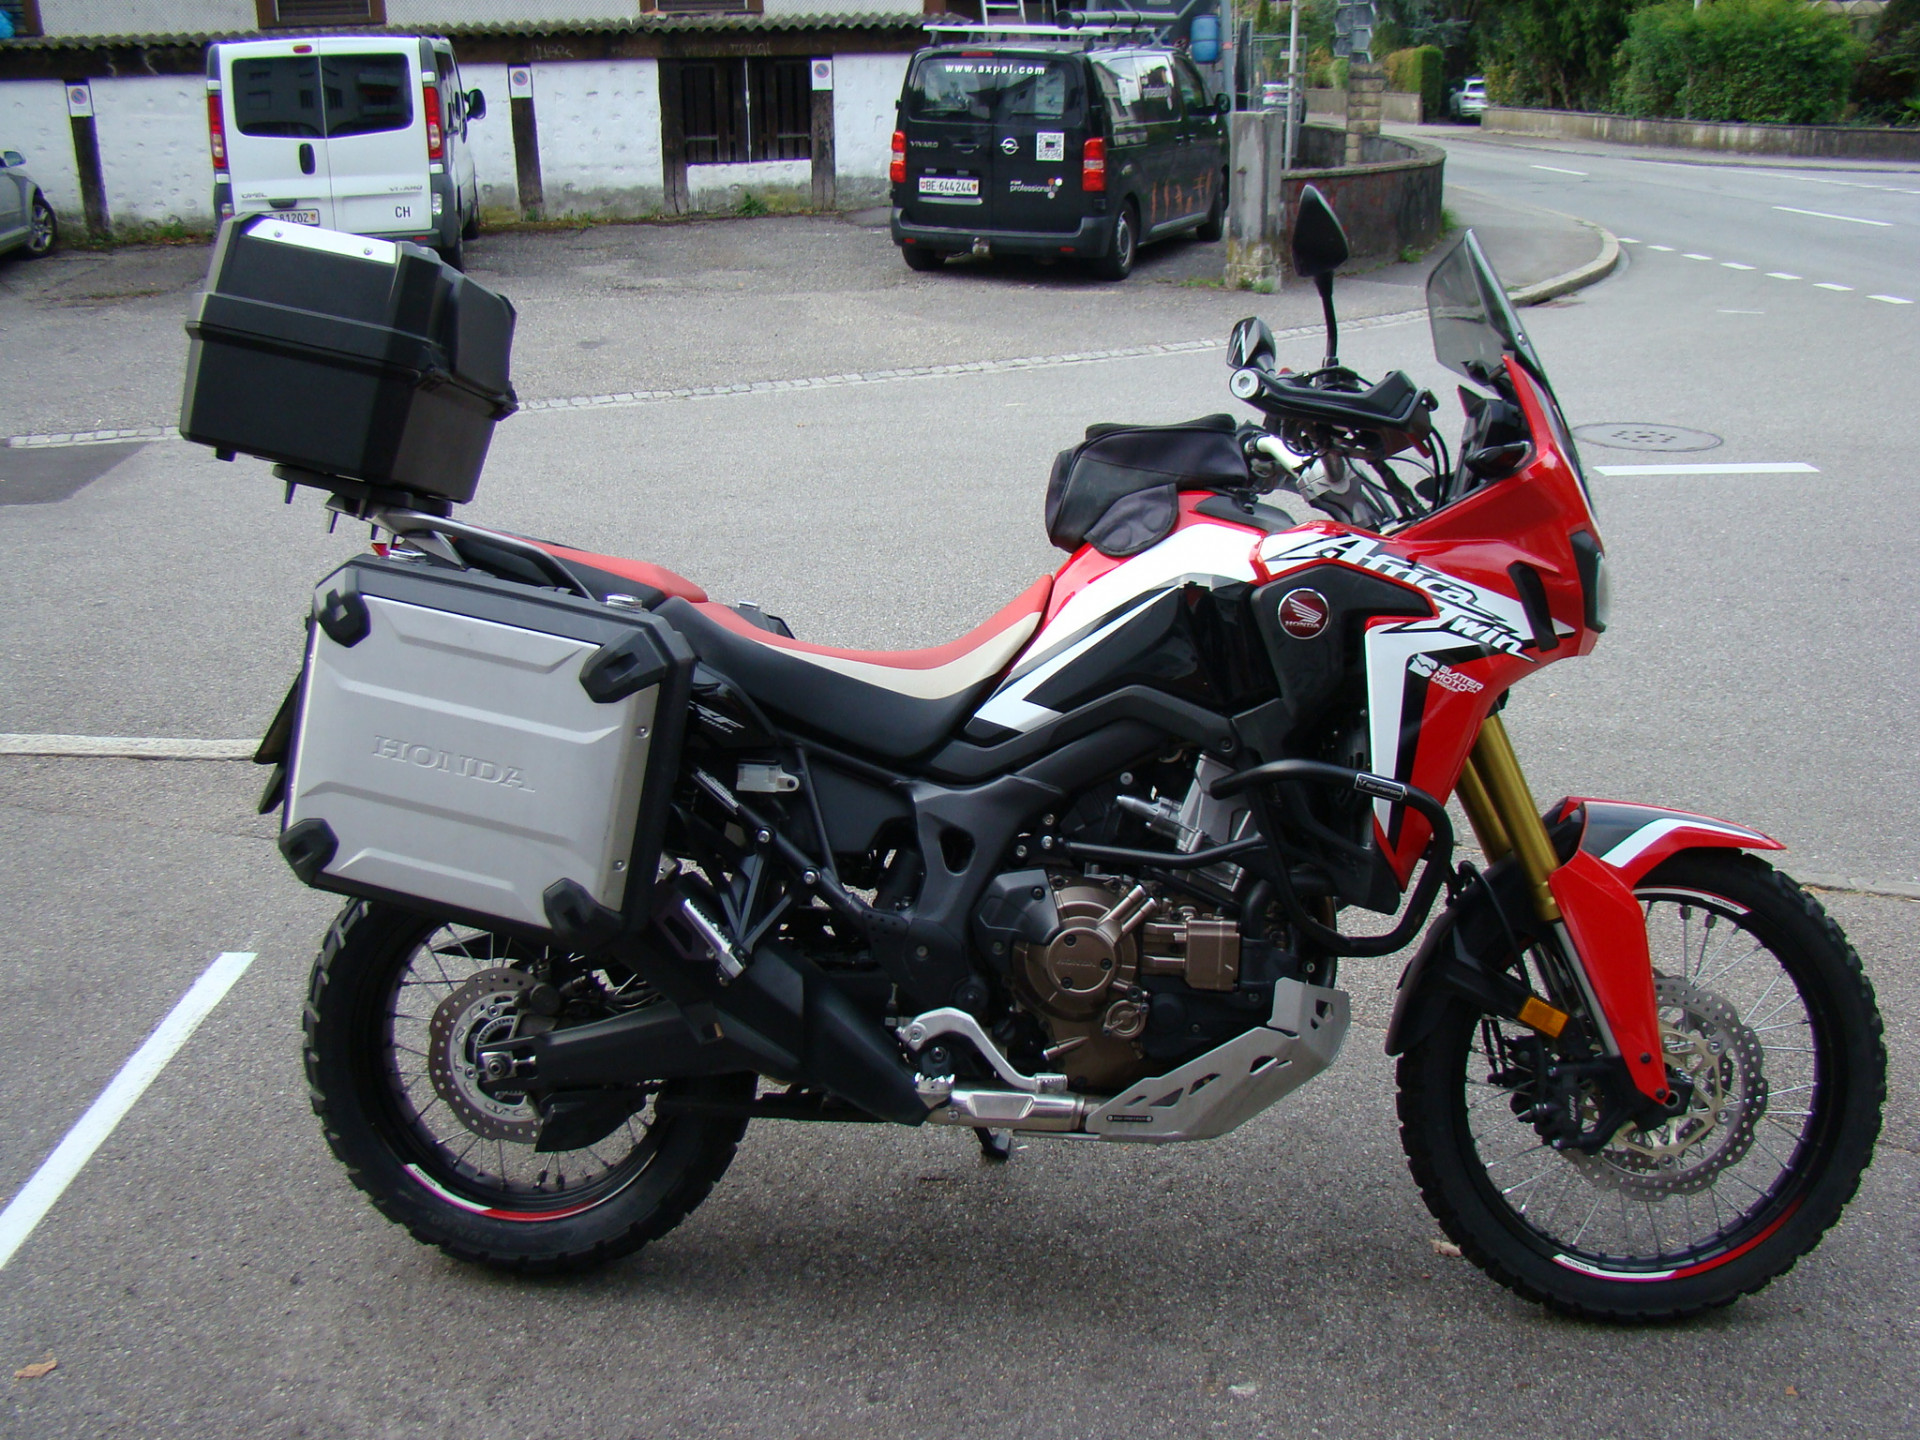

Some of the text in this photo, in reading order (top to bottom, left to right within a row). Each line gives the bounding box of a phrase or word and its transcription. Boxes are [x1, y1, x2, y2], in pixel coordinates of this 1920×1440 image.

[945, 64, 1045, 75] www.axpel.com
[926, 180, 971, 193] BE 644244
[1010, 183, 1051, 193] professional
[279, 212, 309, 224] 81202
[395, 206, 411, 218] CH
[1275, 532, 1480, 606] Africa
[1284, 621, 1320, 629] HONDA
[1432, 671, 1468, 693] MOTO
[371, 735, 536, 793] HONDA
